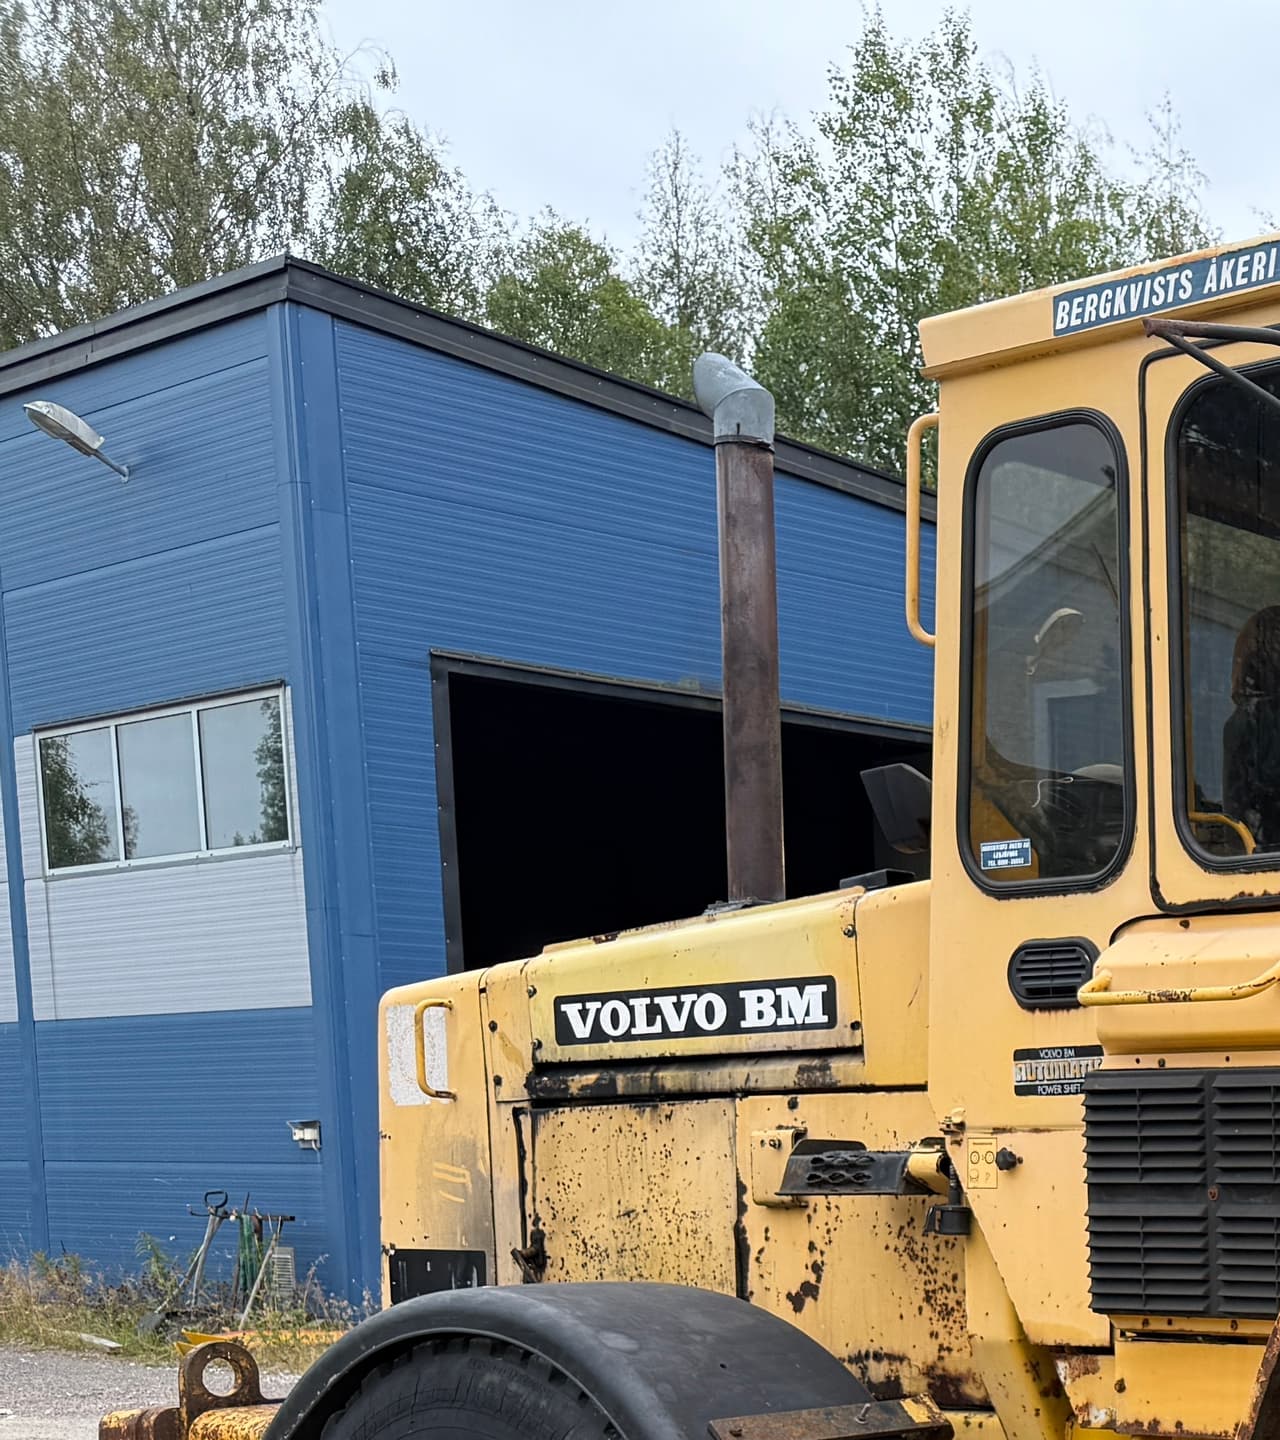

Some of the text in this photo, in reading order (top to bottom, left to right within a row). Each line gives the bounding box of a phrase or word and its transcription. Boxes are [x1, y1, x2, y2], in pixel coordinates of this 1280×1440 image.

[1055, 268, 1193, 331] BERGKVISTS
[1202, 246, 1277, 295] ÅKERI
[560, 983, 829, 1040] VOLVO BM
[1039, 1048, 1075, 1058] VOLVO BM
[1037, 1084, 1081, 1095] POWER SHIFT
